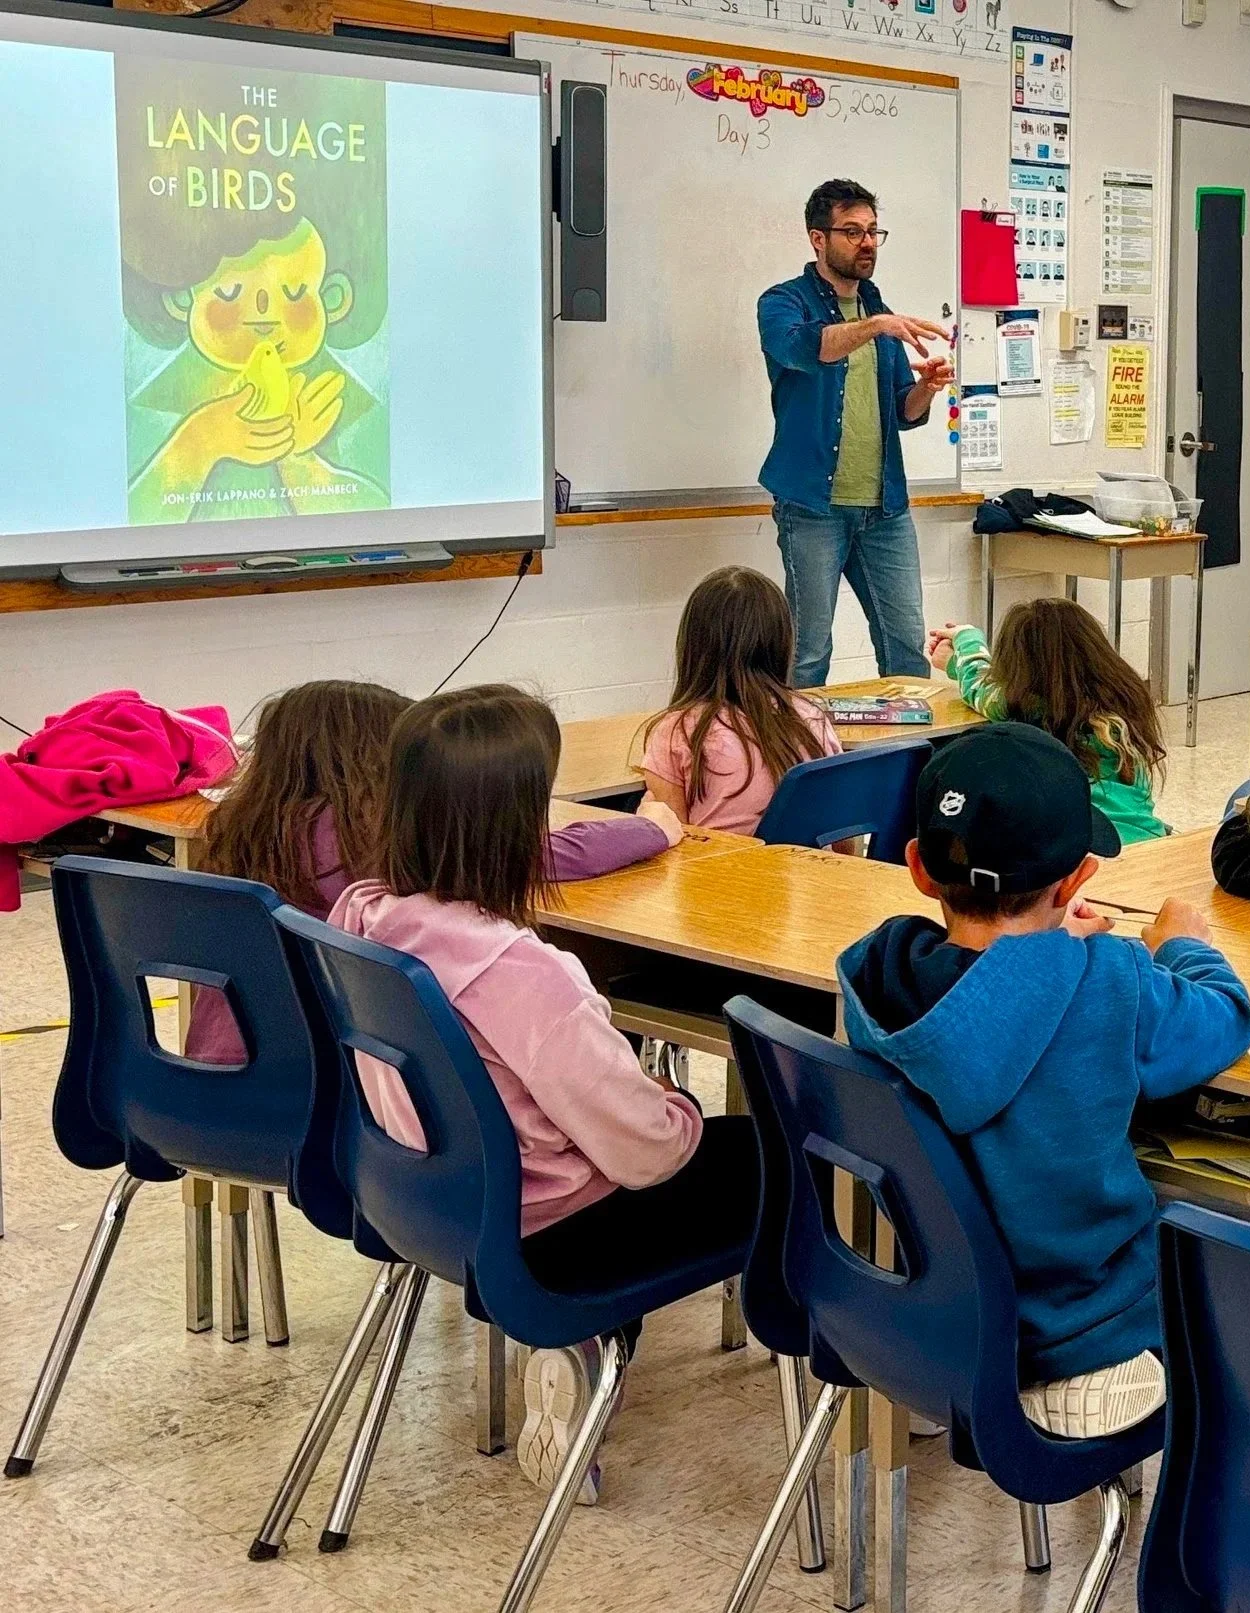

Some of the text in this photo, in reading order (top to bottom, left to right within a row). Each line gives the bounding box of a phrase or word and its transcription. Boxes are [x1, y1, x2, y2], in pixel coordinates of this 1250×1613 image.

[801, 4, 821, 25] Uu
[842, 9, 859, 31] Vv
[873, 15, 903, 37] Ww
[916, 22, 934, 42] Xx
[952, 27, 967, 55] Yy
[985, 33, 1001, 53] Zz
[601, 50, 686, 105] Thursday,
[713, 68, 807, 113] February
[240, 85, 277, 108] THE
[147, 106, 366, 163] LANGUAGE
[717, 113, 771, 156] Day 3
[149, 165, 297, 213] OF BIRDS
[1112, 366, 1144, 383] FIRE
[1110, 393, 1145, 405] ALARM
[162, 483, 359, 506] JON-ERIK LAPPANO & ZACH MANBECK
[834, 711, 848, 721] DOG
[849, 712, 863, 721] MAN
